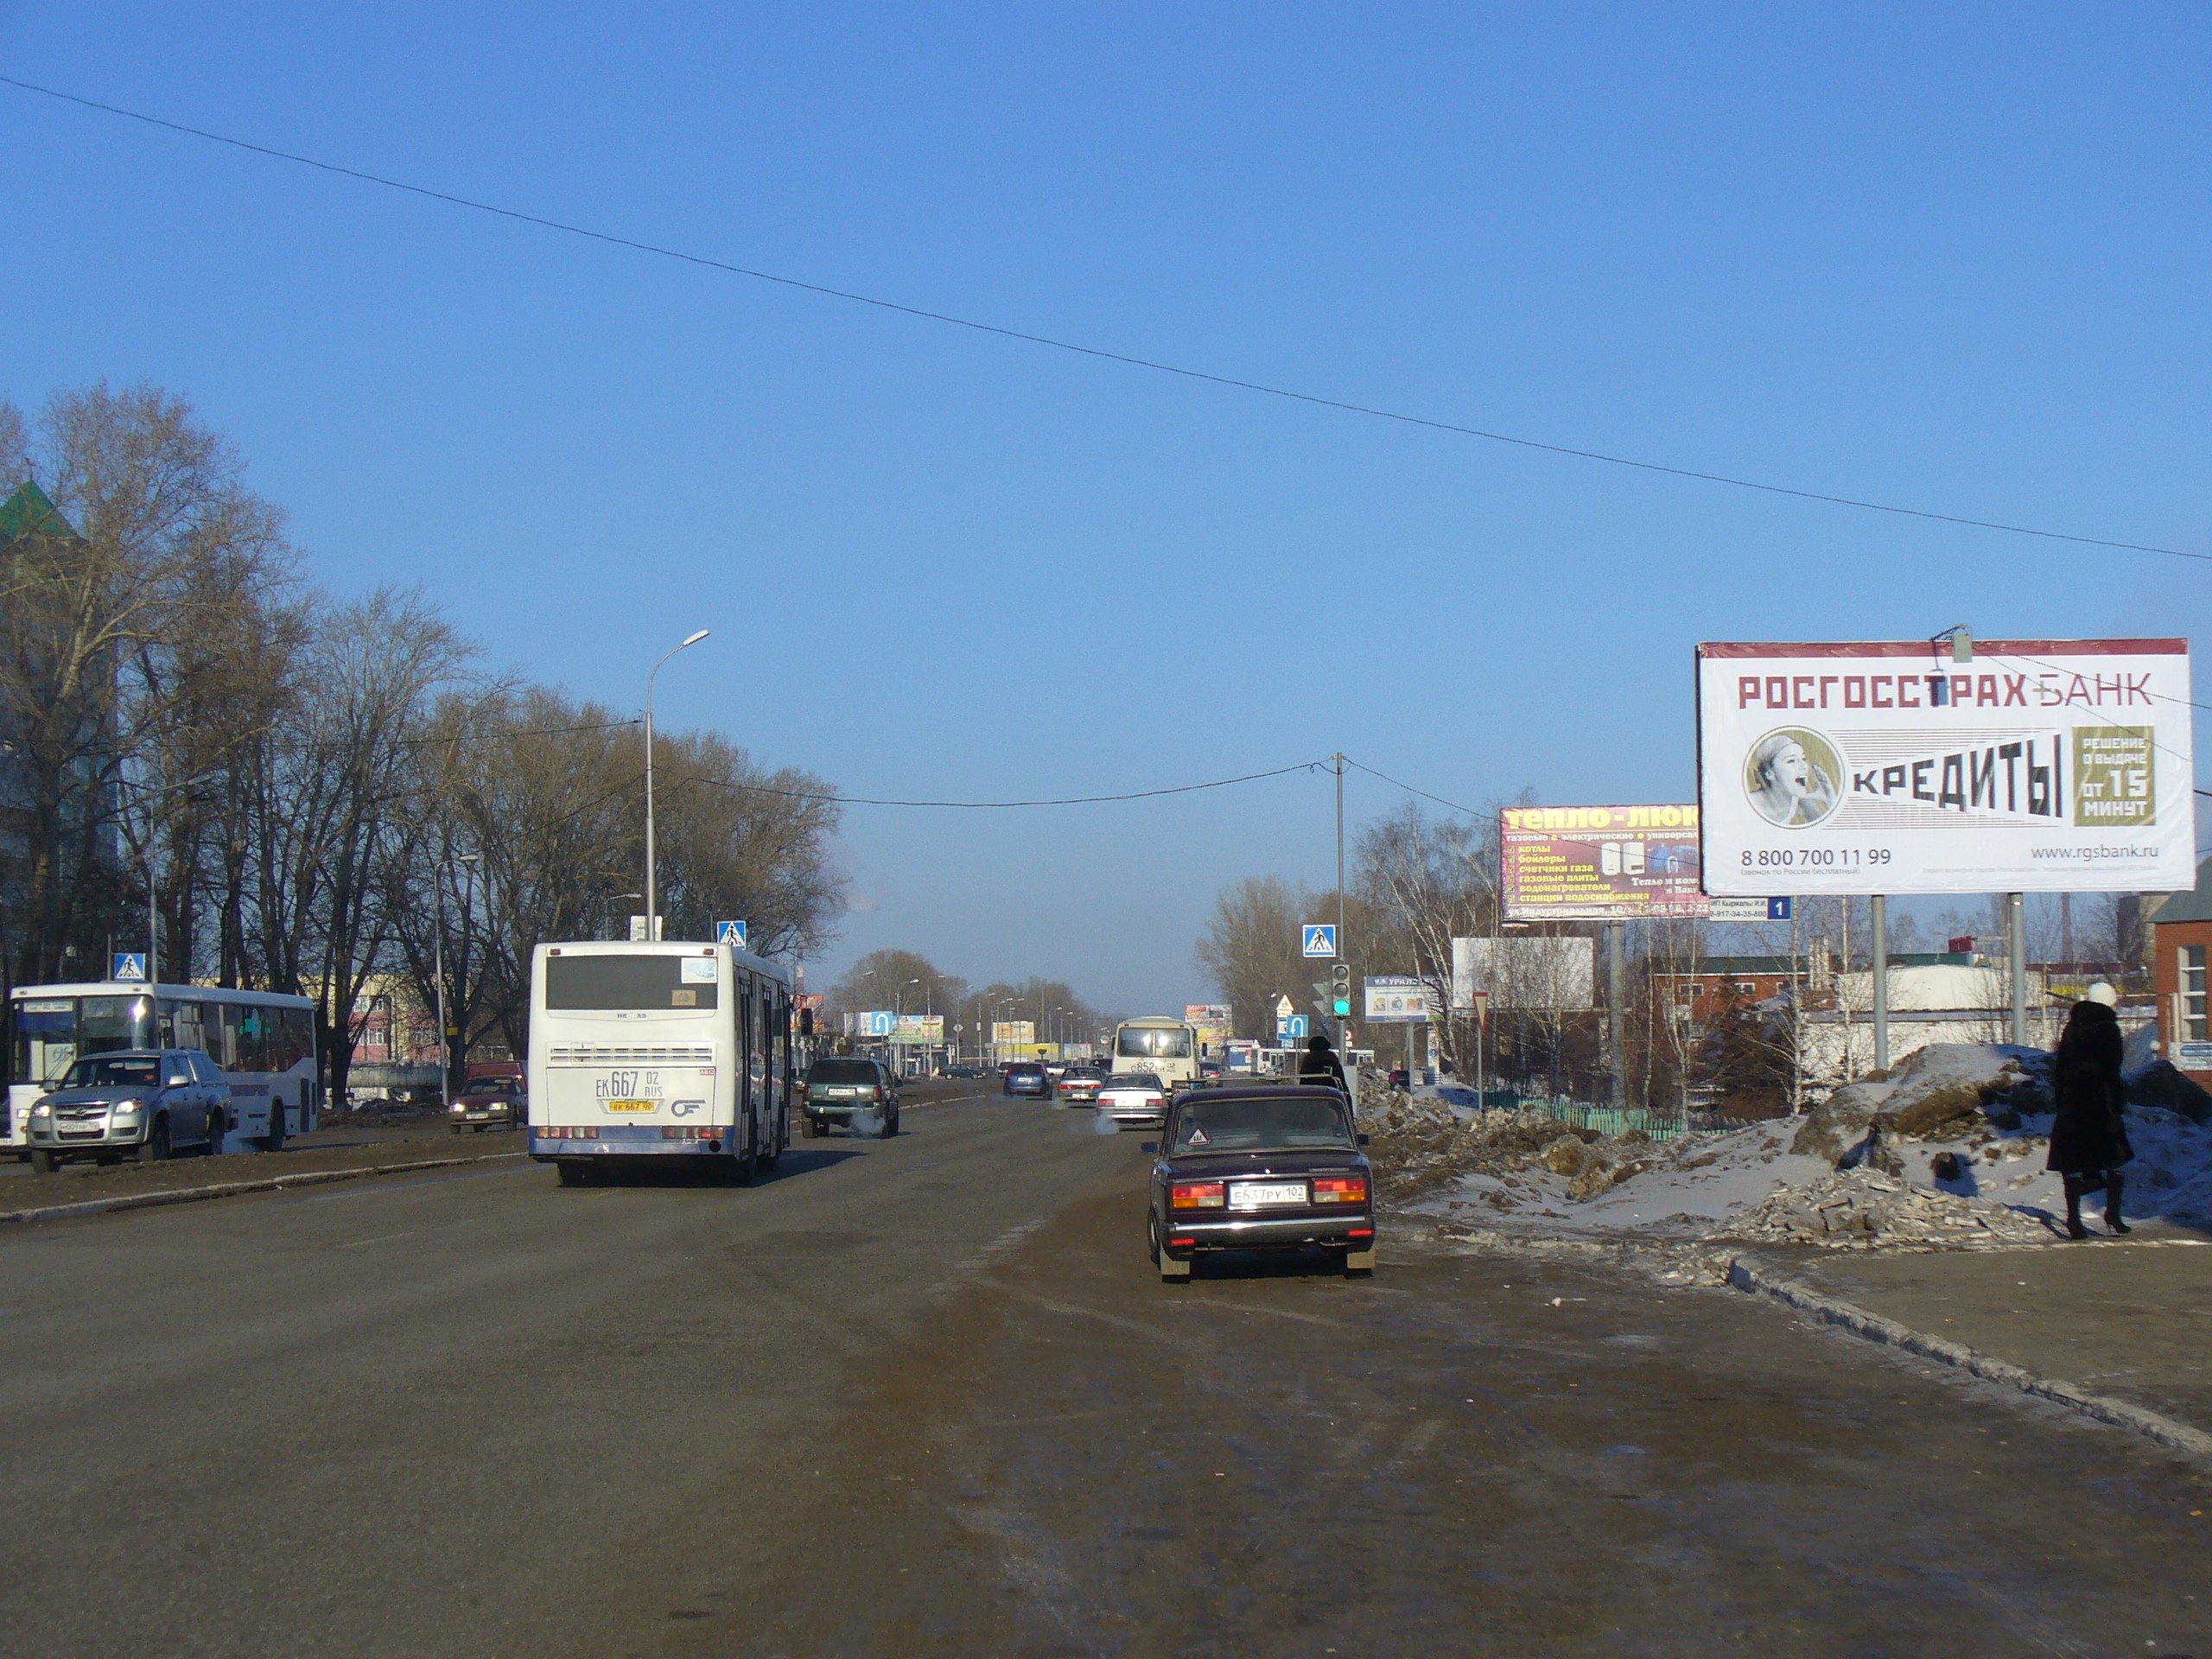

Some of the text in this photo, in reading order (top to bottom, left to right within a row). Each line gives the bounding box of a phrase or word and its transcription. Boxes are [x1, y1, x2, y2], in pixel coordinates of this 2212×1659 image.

[1738, 672, 2152, 709] РОСГОССТРАХ БАНК
[2082, 737, 2147, 749] РЕШЕНИЕ
[2094, 753, 2147, 765] ВЫДАЧЕ
[1853, 734, 2063, 818] КРЕДИТЫ
[2082, 770, 2147, 797] ОТ 15
[2083, 801, 2148, 817] МИНУТ
[1561, 832, 1634, 842] электрические
[1519, 855, 1567, 863] бойлеры
[1741, 849, 1891, 866] 8 800 700 11 99
[2031, 844, 2159, 861] www.rgsbank.ru
[1520, 883, 1611, 893] водонагреватели
[1520, 892, 1649, 903] станции водоснабжения
[1776, 901, 1783, 916] 1
[646, 1071, 659, 1085] 02
[645, 1087, 663, 1097] RUS
